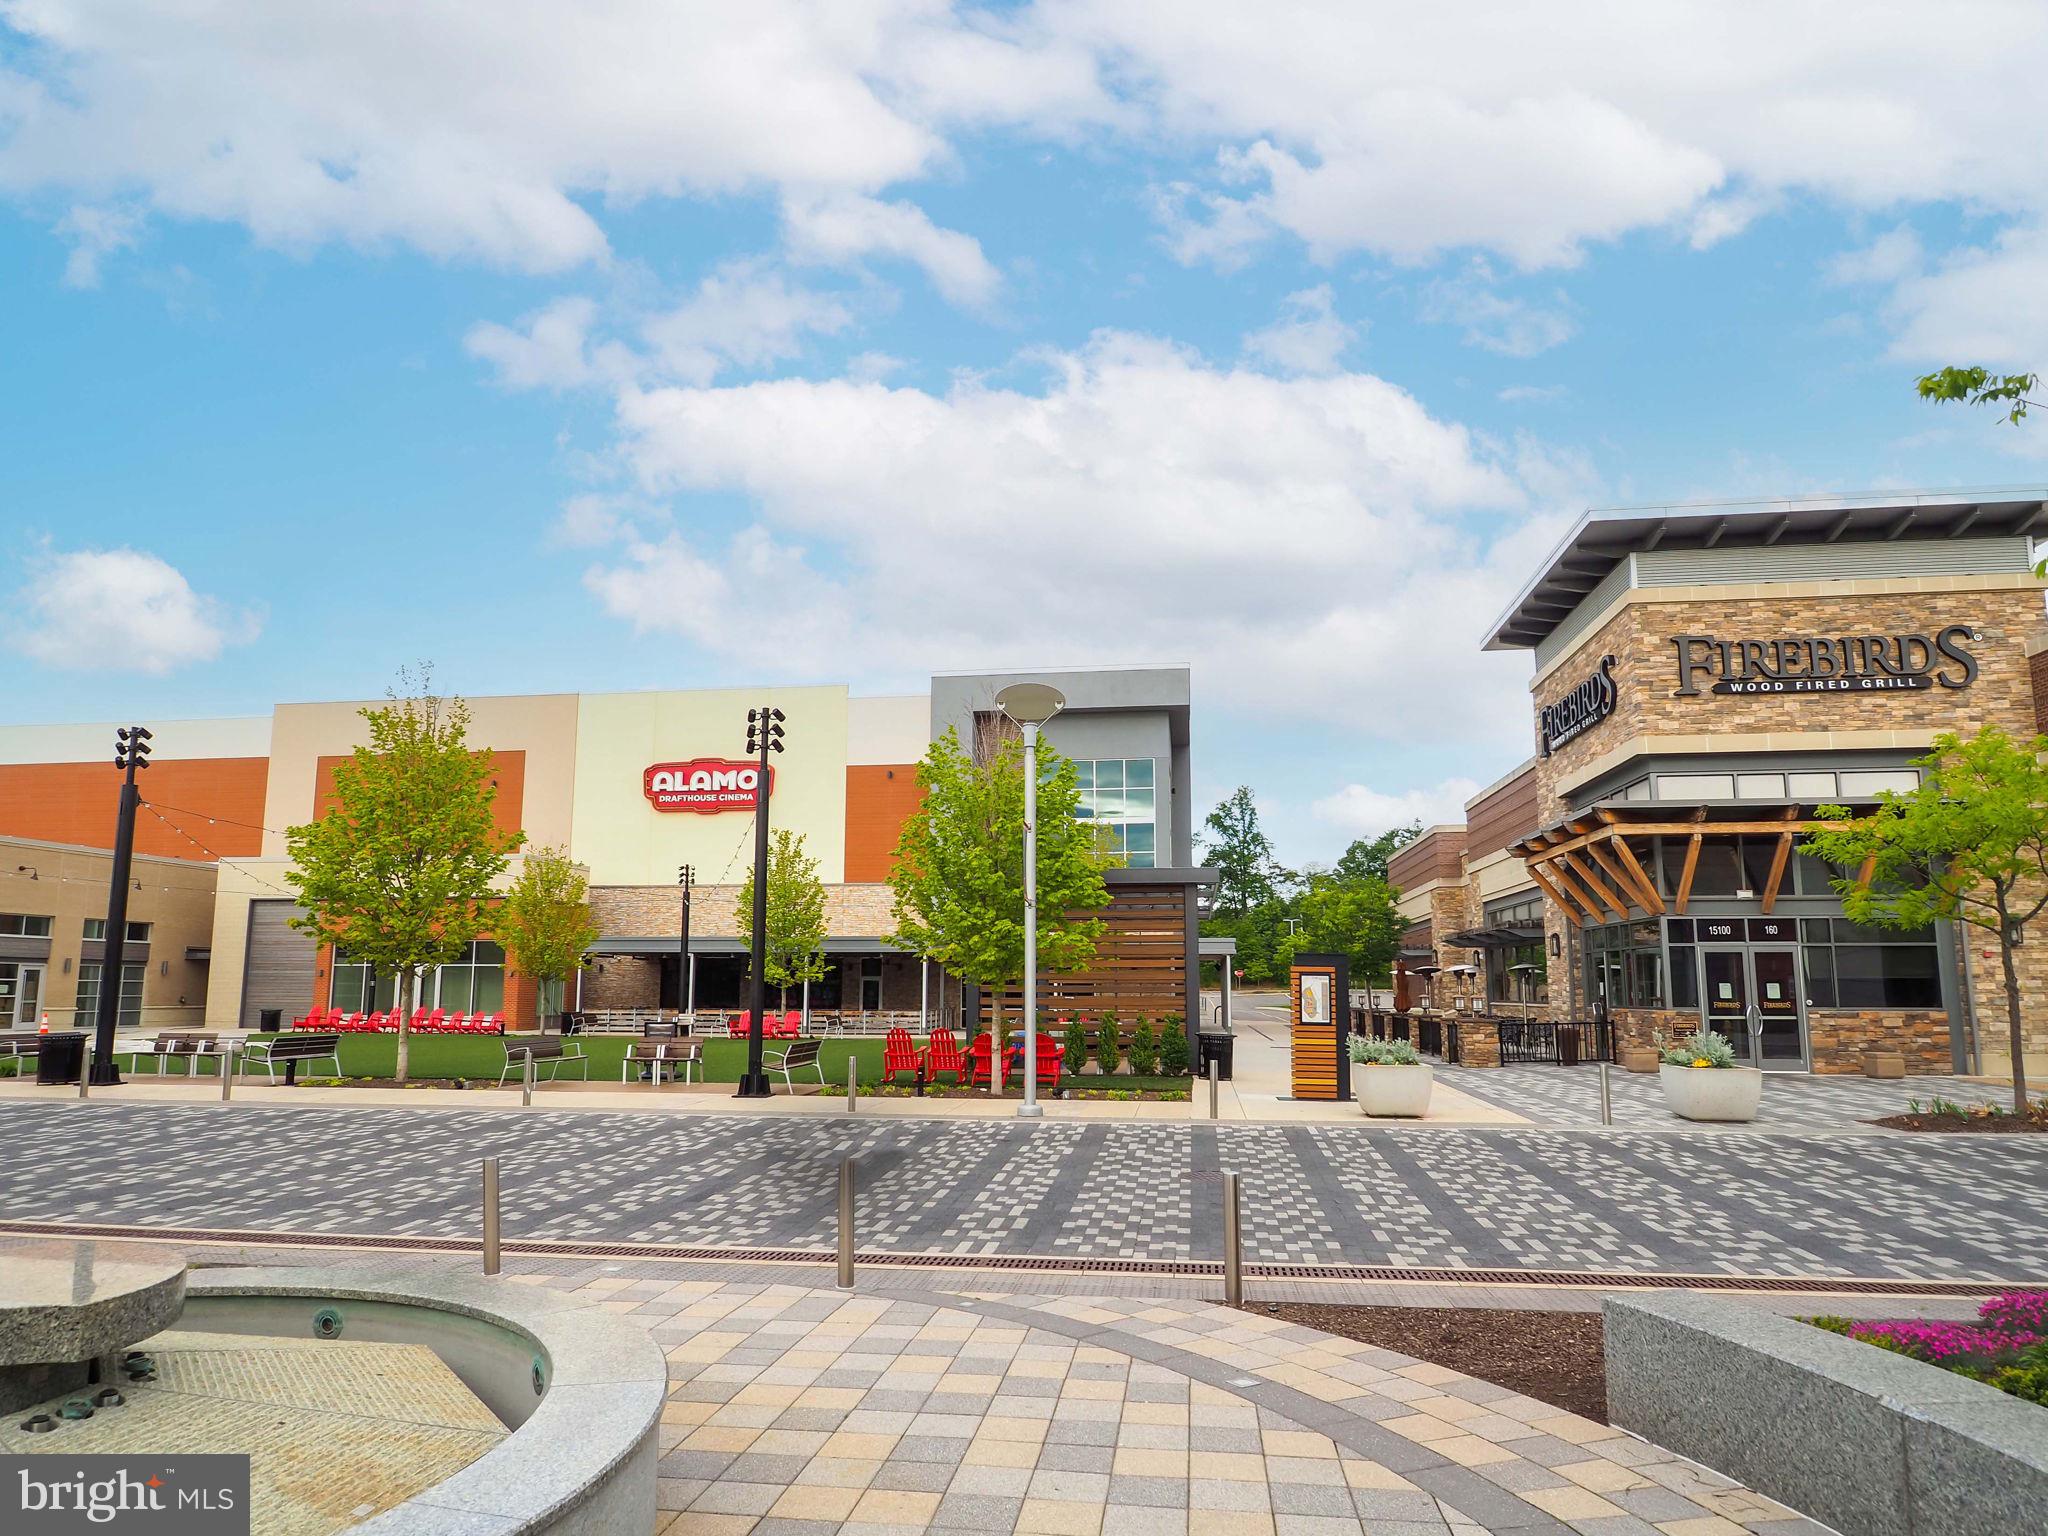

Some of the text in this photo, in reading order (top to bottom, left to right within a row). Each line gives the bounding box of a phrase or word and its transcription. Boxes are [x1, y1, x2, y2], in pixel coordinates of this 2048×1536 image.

[1670, 626, 1978, 696] FIREBIRDS
[1730, 677, 1917, 693] WOOD FIRED GRILL
[1540, 655, 1618, 758] FIREBIRDS
[652, 769, 759, 792] ALAMO
[659, 793, 753, 802] DRAFTHOUSE CINEMA
[1709, 925, 1731, 935] 15100
[1765, 925, 1778, 935] 160
